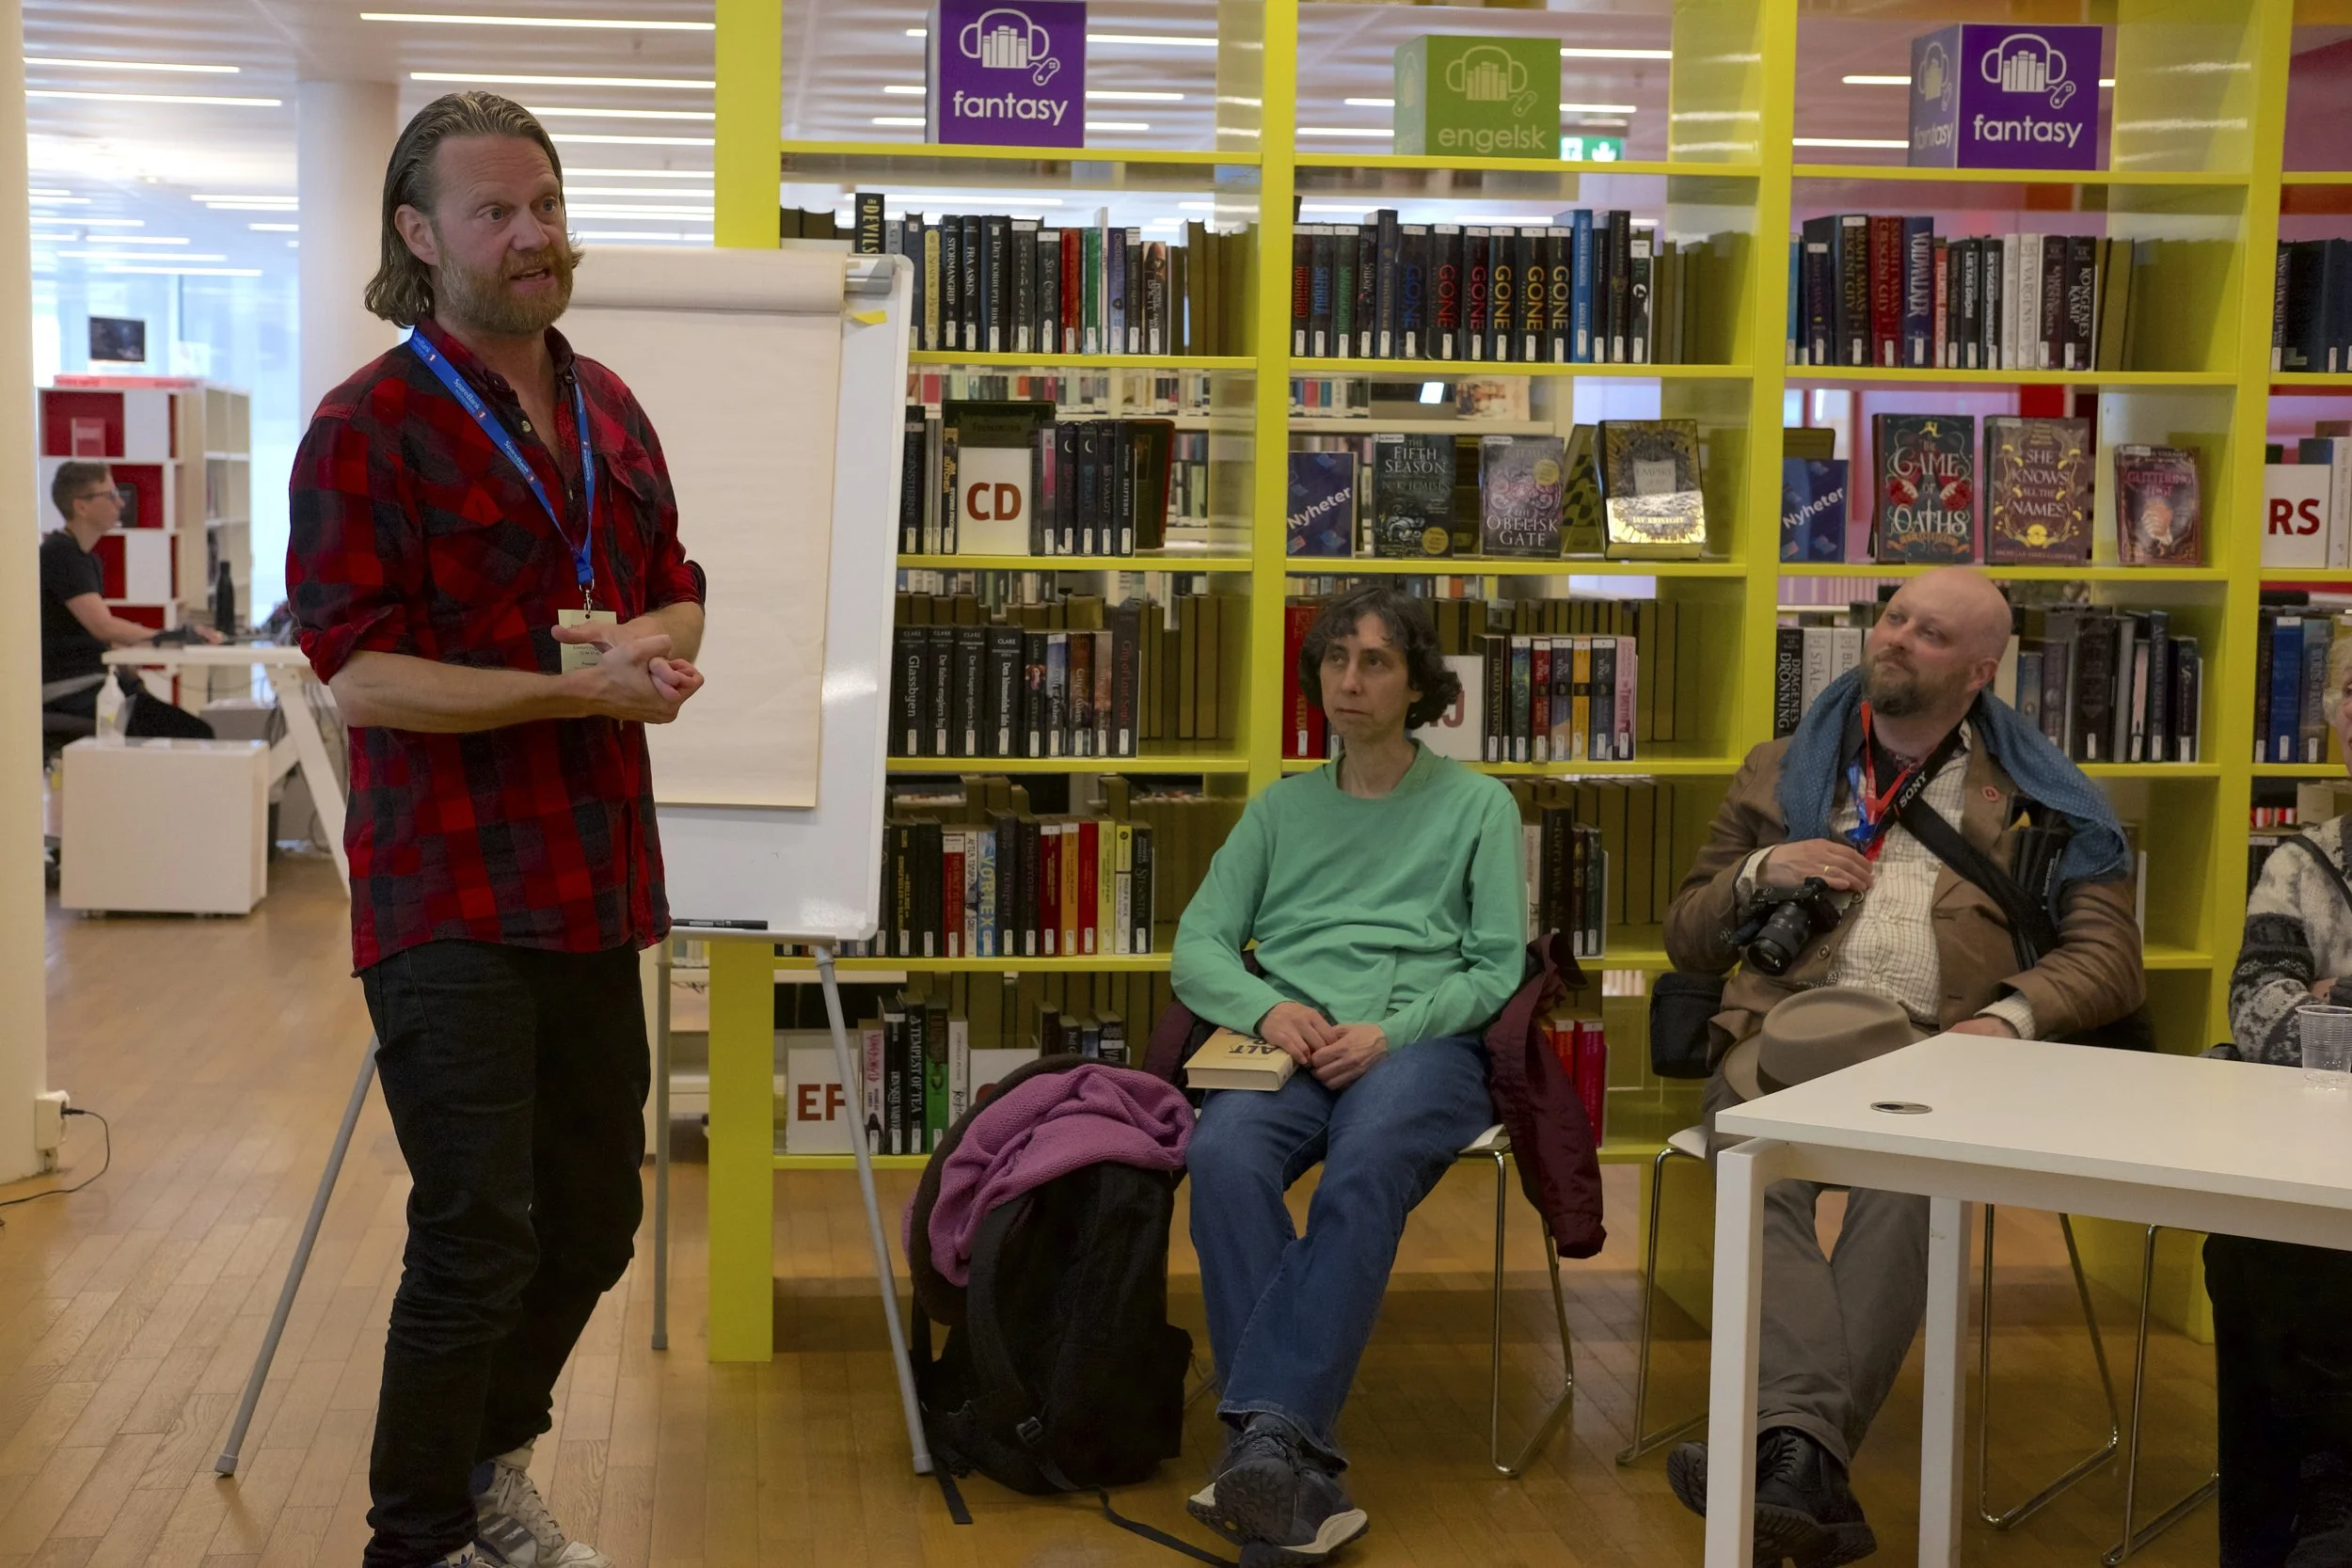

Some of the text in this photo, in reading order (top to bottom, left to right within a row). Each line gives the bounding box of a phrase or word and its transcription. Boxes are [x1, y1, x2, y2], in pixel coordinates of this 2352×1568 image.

[953, 90, 1069, 126] fantasy
[1438, 124, 1546, 153] engelsk
[1914, 122, 1954, 150] fantasy
[1973, 114, 2083, 149] fantasy
[862, 205, 880, 253] DEVILS
[1856, 227, 1866, 261] ARAH
[992, 241, 1001, 260] DET
[1845, 227, 1854, 277] RESCENT
[1879, 222, 1888, 311] CRESCENT CITY
[946, 237, 956, 305] STORMANGREP
[965, 246, 975, 296] FRA ASKEN
[991, 262, 999, 305] KORRUPTE
[1908, 231, 1931, 318] VOIDWALKER
[1404, 264, 1422, 328] GONE
[1437, 264, 1455, 328] GONE
[1470, 266, 1486, 330] GONE
[1494, 265, 1511, 329] GONE
[1527, 266, 1544, 329] GONE
[1552, 266, 1569, 329] GONE
[2069, 285, 2080, 323] KAMP
[2080, 268, 2091, 338] KONGENES
[453, 378, 481, 410] SpareBank
[1385, 459, 1446, 474] SEASON
[1394, 446, 1437, 460] FIFTH
[1894, 447, 1961, 477] GAME
[2026, 450, 2055, 465] SHE
[1922, 483, 1936, 494] OF
[2011, 471, 2069, 485] KNOWS
[2040, 488, 2056, 498] THE
[966, 482, 1022, 521] CD
[1287, 486, 1352, 530] Nyheter
[1783, 486, 1844, 529] Nyheter
[1894, 503, 1967, 535] OATHS
[2011, 501, 2065, 517] NAMES
[2268, 498, 2321, 535] RS
[1486, 516, 1558, 532] OBELISK
[1500, 531, 1547, 546] GATE
[939, 655, 947, 666] De
[969, 656, 977, 666] De
[1120, 640, 1132, 660] City
[1811, 652, 1825, 684] STÅL
[904, 655, 920, 717] Glassbyen
[1002, 662, 1011, 675] Den
[1121, 677, 1131, 697] Lost
[1778, 653, 1791, 729] DRONNING
[1790, 658, 1801, 722] DRAGENES
[1052, 699, 1060, 725] Ashes
[1120, 700, 1131, 725] Souls
[1899, 771, 1927, 808] SONY
[980, 855, 994, 927] VORTEX
[910, 1016, 922, 1114] A TEMPEST OF TEA
[797, 1084, 846, 1121] EF
